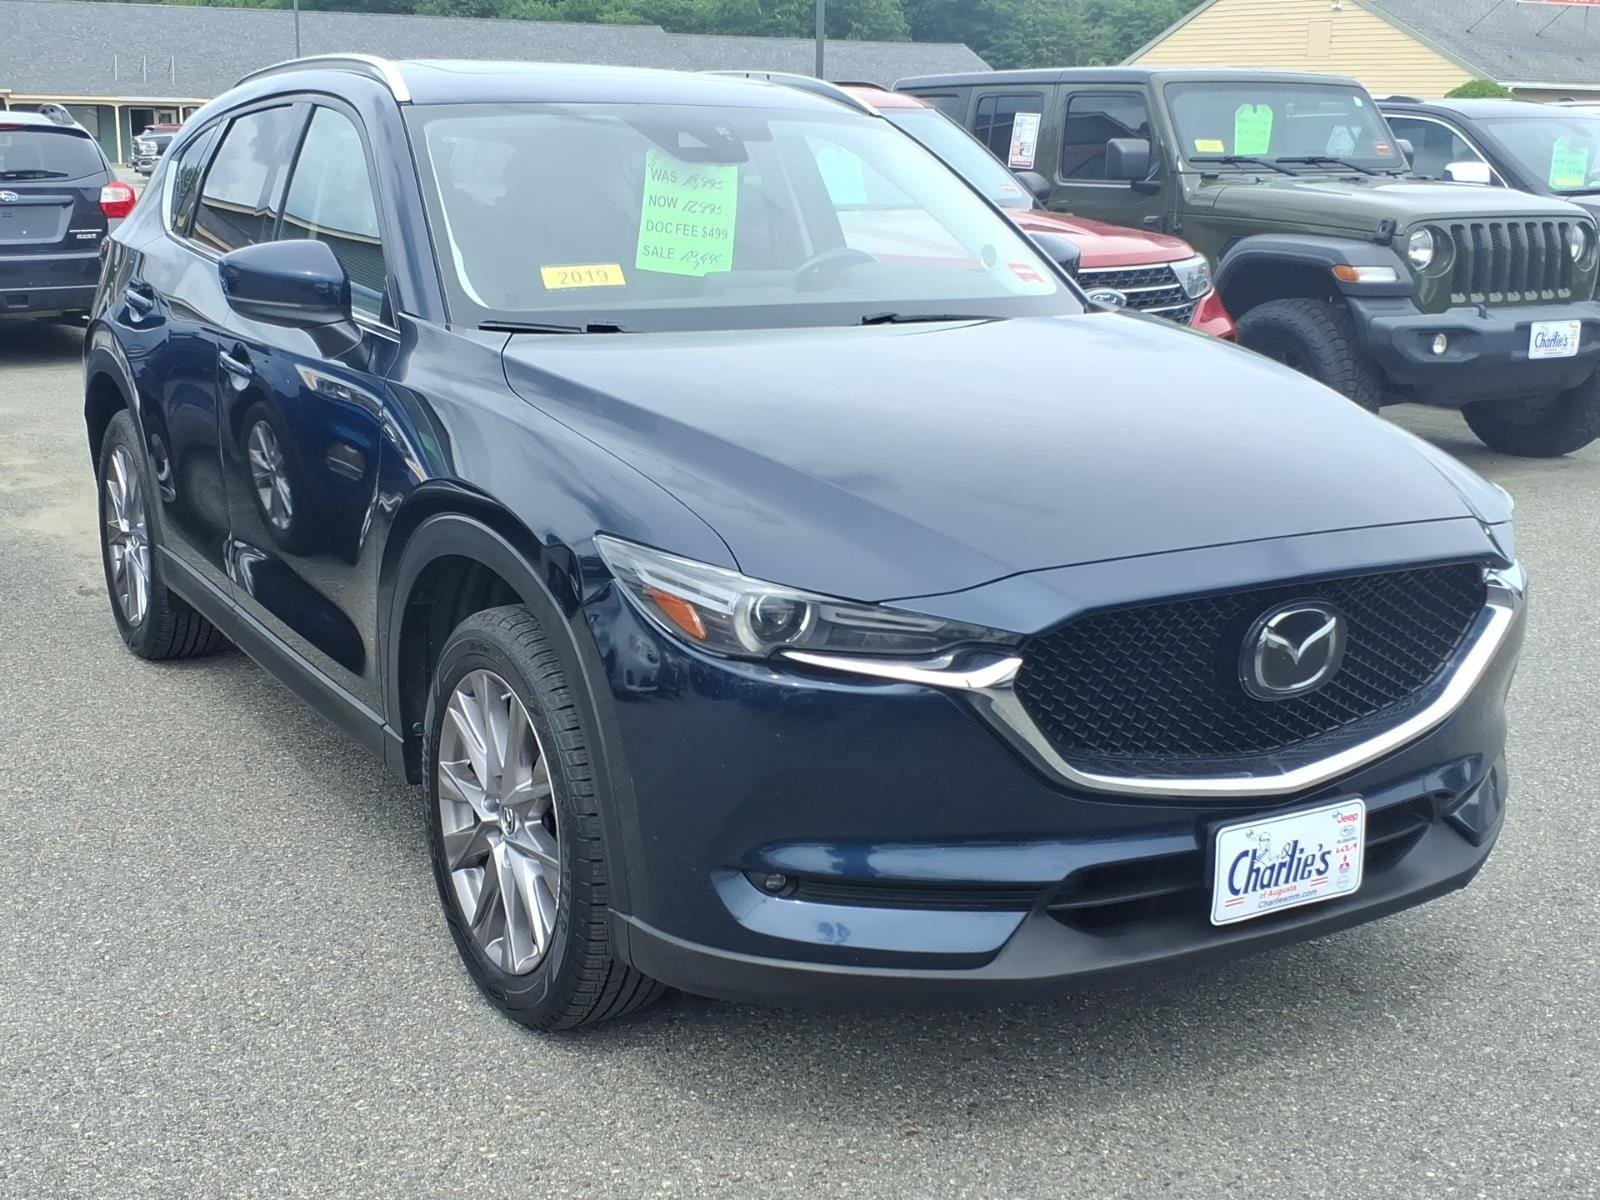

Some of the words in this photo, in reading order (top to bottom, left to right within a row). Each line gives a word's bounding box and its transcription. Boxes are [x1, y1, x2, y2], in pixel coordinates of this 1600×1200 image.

[650, 167, 678, 184] WAS
[648, 194, 678, 209] NOW
[646, 220, 673, 234] DOC
[675, 223, 698, 237] FEE
[702, 226, 728, 240] $499
[642, 245, 675, 259] SALE
[557, 269, 609, 284] 2019
[1535, 331, 1568, 348] Charlie's
[1336, 812, 1359, 824] Jeep
[1228, 840, 1331, 896] Charlie's
[1259, 891, 1266, 899] of
[1268, 885, 1297, 896] Augusta
